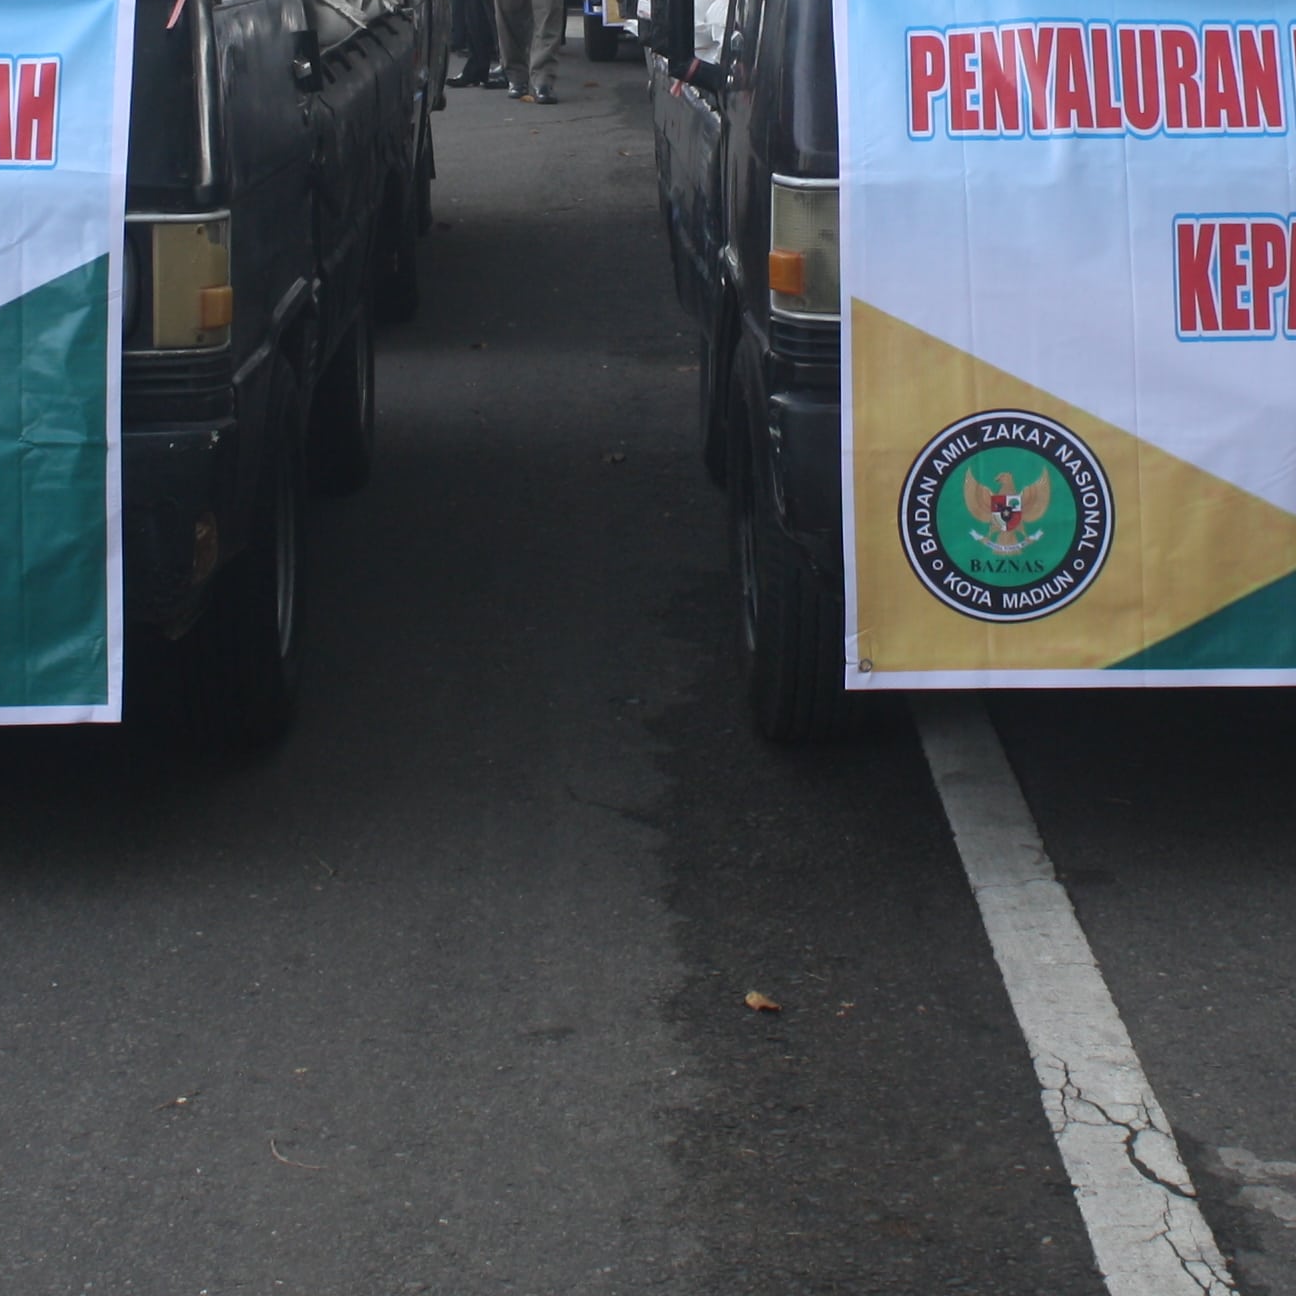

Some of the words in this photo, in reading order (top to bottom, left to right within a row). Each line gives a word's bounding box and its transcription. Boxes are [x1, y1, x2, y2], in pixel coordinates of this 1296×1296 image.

[907, 28, 1282, 134] PENYALURAN
[914, 476, 939, 555] BADAN
[932, 434, 977, 475] AMIL
[980, 423, 1056, 449] ZAKAT
[1055, 444, 1100, 552] NASIONAL
[943, 571, 993, 608] KOTA
[1003, 569, 1075, 609] MADIUN
[969, 558, 1045, 574] BAZNAS
